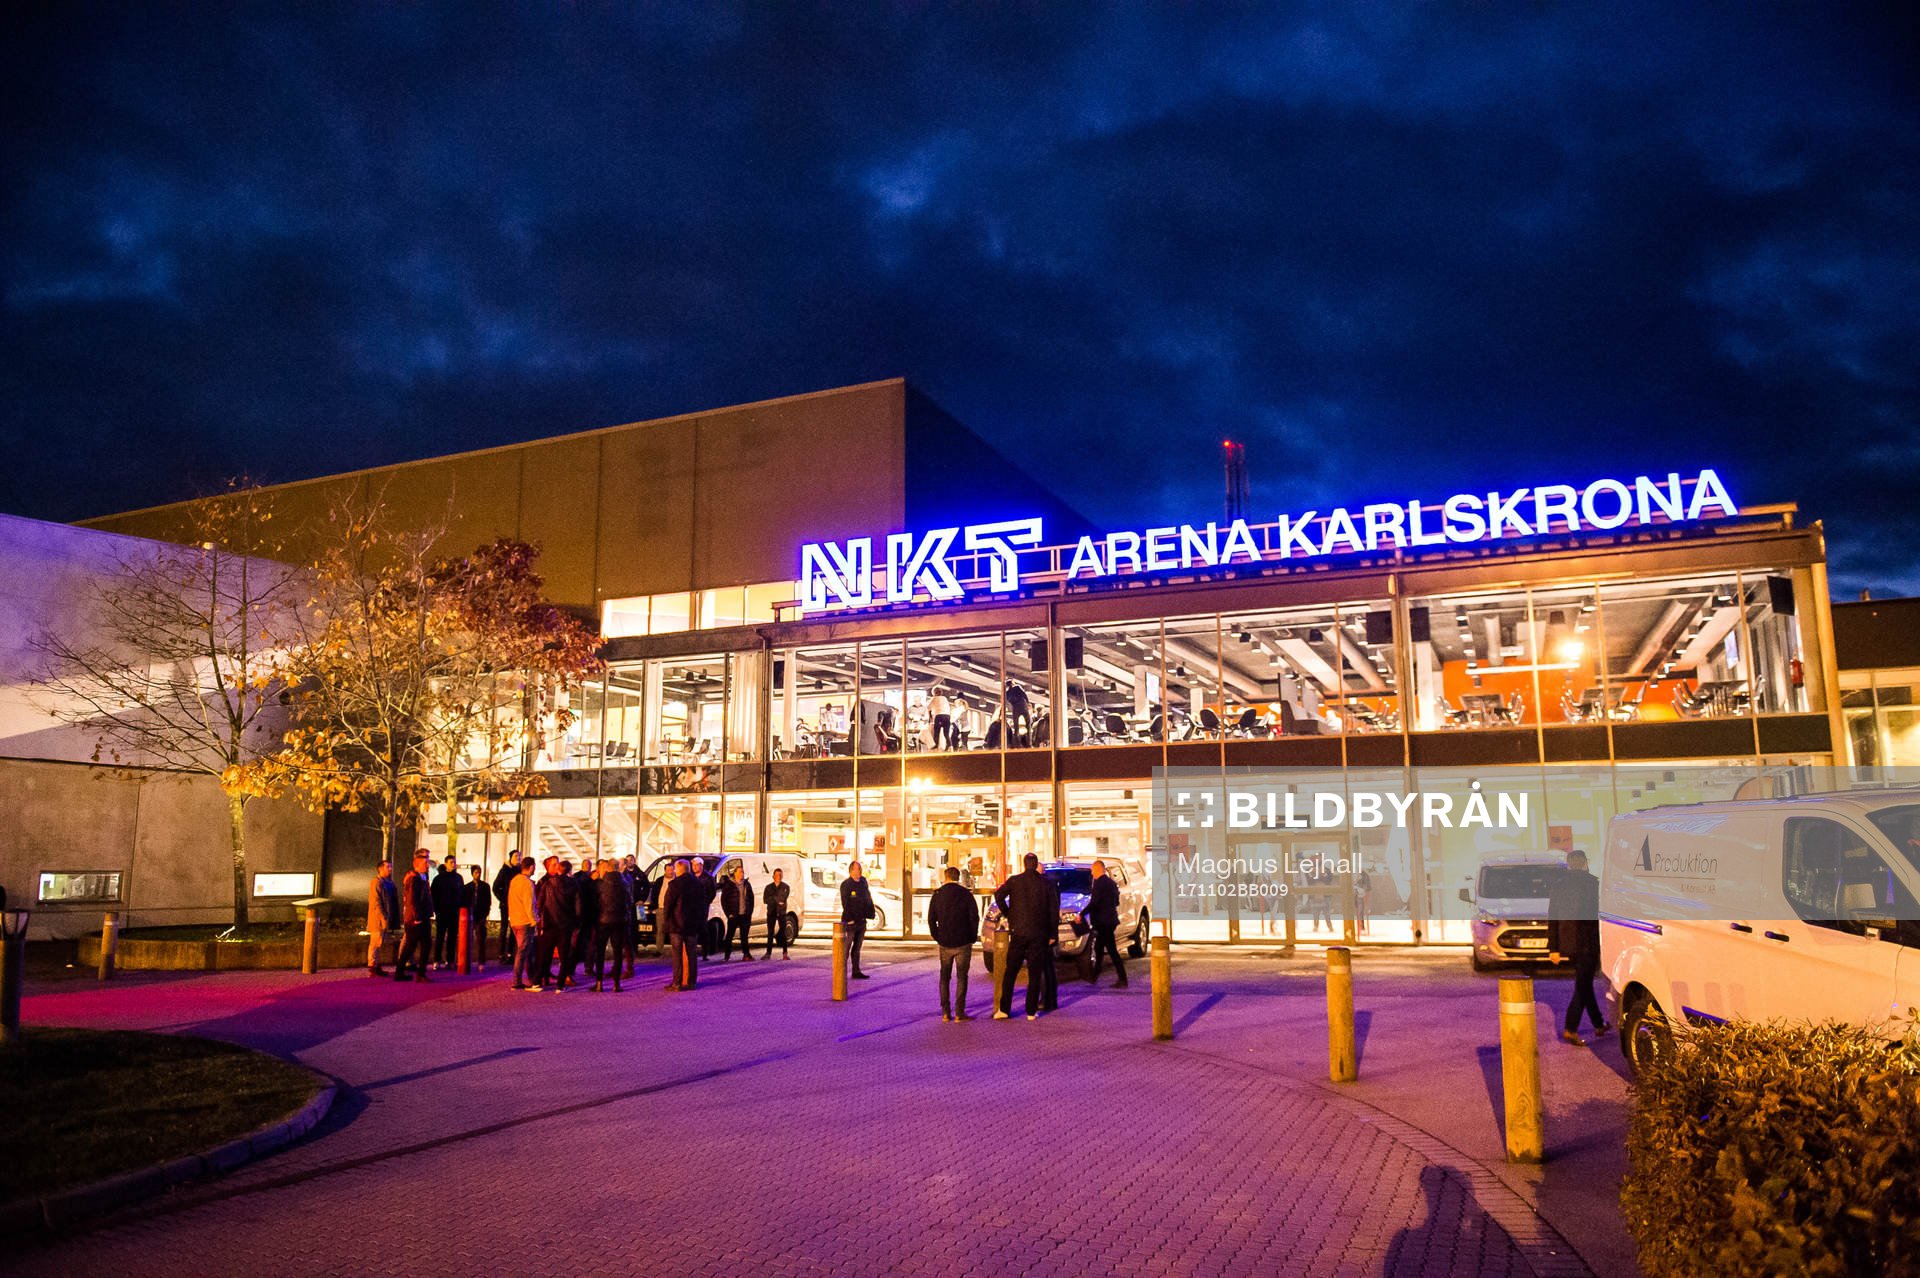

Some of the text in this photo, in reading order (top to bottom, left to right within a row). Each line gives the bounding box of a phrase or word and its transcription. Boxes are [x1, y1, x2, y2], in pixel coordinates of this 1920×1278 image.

[802, 469, 1737, 613] NKT ARENA KARLSKRONA
[1654, 852, 1718, 874] Produktion
